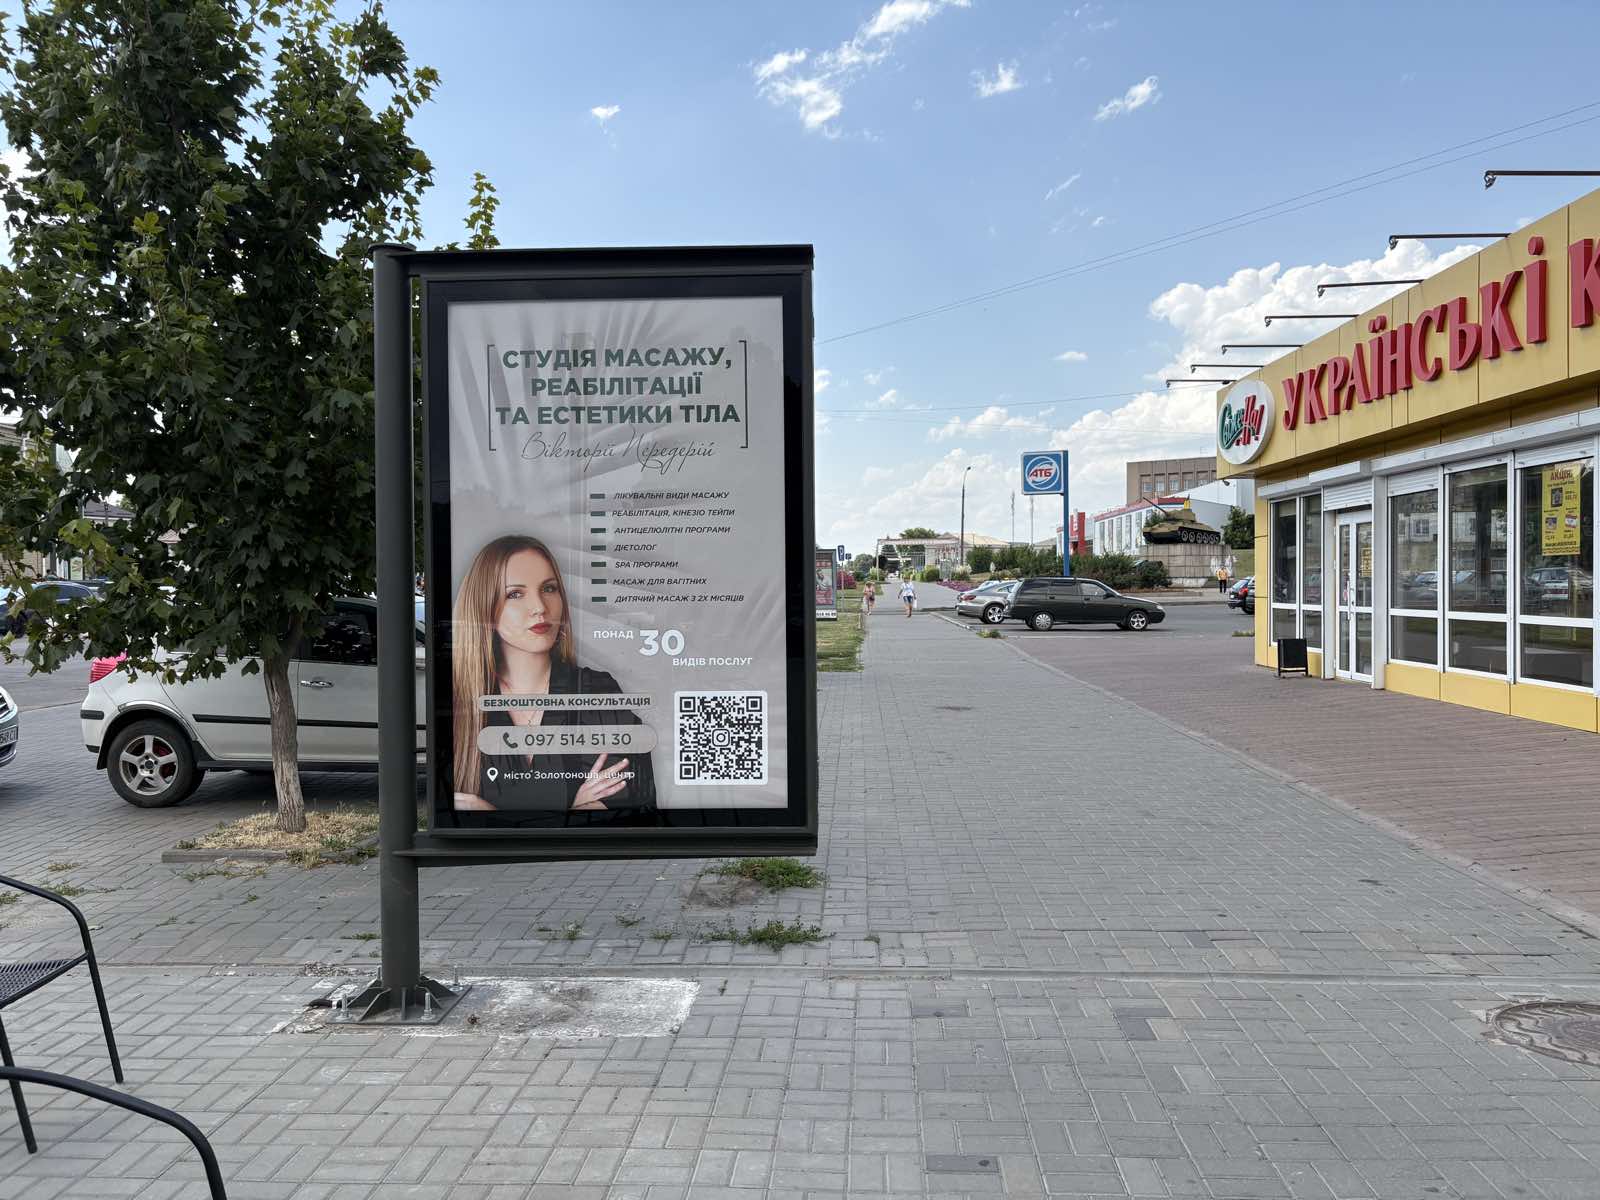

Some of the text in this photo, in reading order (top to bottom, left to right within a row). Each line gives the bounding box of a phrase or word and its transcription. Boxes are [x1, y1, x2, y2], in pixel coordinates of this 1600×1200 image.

[1281, 236, 1547, 431] УКРАЇНСЬКІ
[502, 347, 732, 371] СТУДІЯ МАСАЖУ,
[531, 371, 703, 397] РЕАБІЛІТАЦІЇ
[496, 404, 741, 424] ТА ЕСТЕТИКИ ТІЛА
[521, 431, 616, 472] Вікторії
[1030, 467, 1054, 477] АТБ
[613, 491, 730, 500] ЛІКУВАЛЬНІ ВИДИ МАСАЖУ
[612, 509, 671, 517] РЕАБІЛІТАЦІЯ,
[707, 507, 736, 516] ТЕЙПИ
[614, 526, 683, 534] АНТИЦЕЛЮЛІТНІ
[614, 543, 657, 552] ДІЄТОЛОГ
[612, 578, 708, 586] МАСАЖ ДЛЯ ВАГІТНИХ
[614, 594, 655, 603] ДИТЯЧИЙ
[710, 594, 745, 602] МІСЯЦІВ
[593, 629, 685, 656] ПОНАД 30
[672, 656, 753, 668] ВИДІВ ПОСЛУГ
[484, 697, 651, 707] БЕЗКОШТОВНА КОНСУЛЬТАЦІЯ
[524, 733, 632, 746] 097 514 51 30
[503, 771, 532, 780] місто
